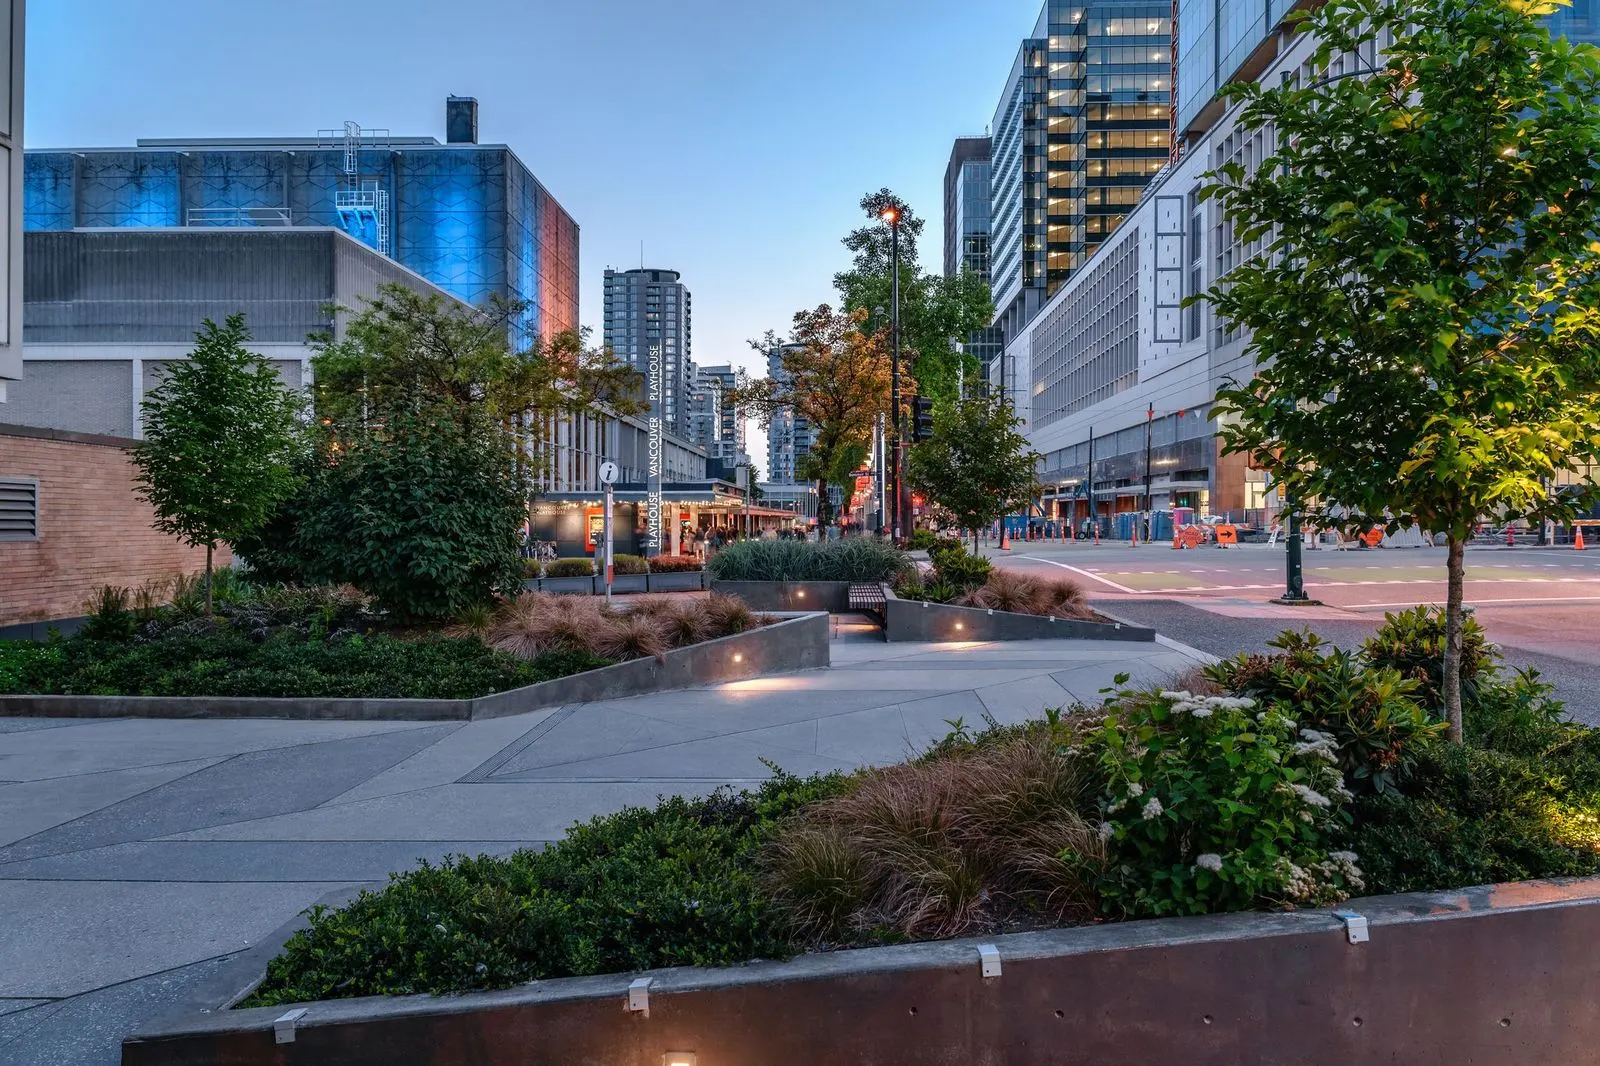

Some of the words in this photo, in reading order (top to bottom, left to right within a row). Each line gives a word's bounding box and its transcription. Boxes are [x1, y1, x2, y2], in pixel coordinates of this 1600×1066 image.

[649, 345, 659, 400] PLAYHOUSE
[649, 417, 658, 477] VANCOUVER
[649, 492, 658, 547] PLAYHOUSE
